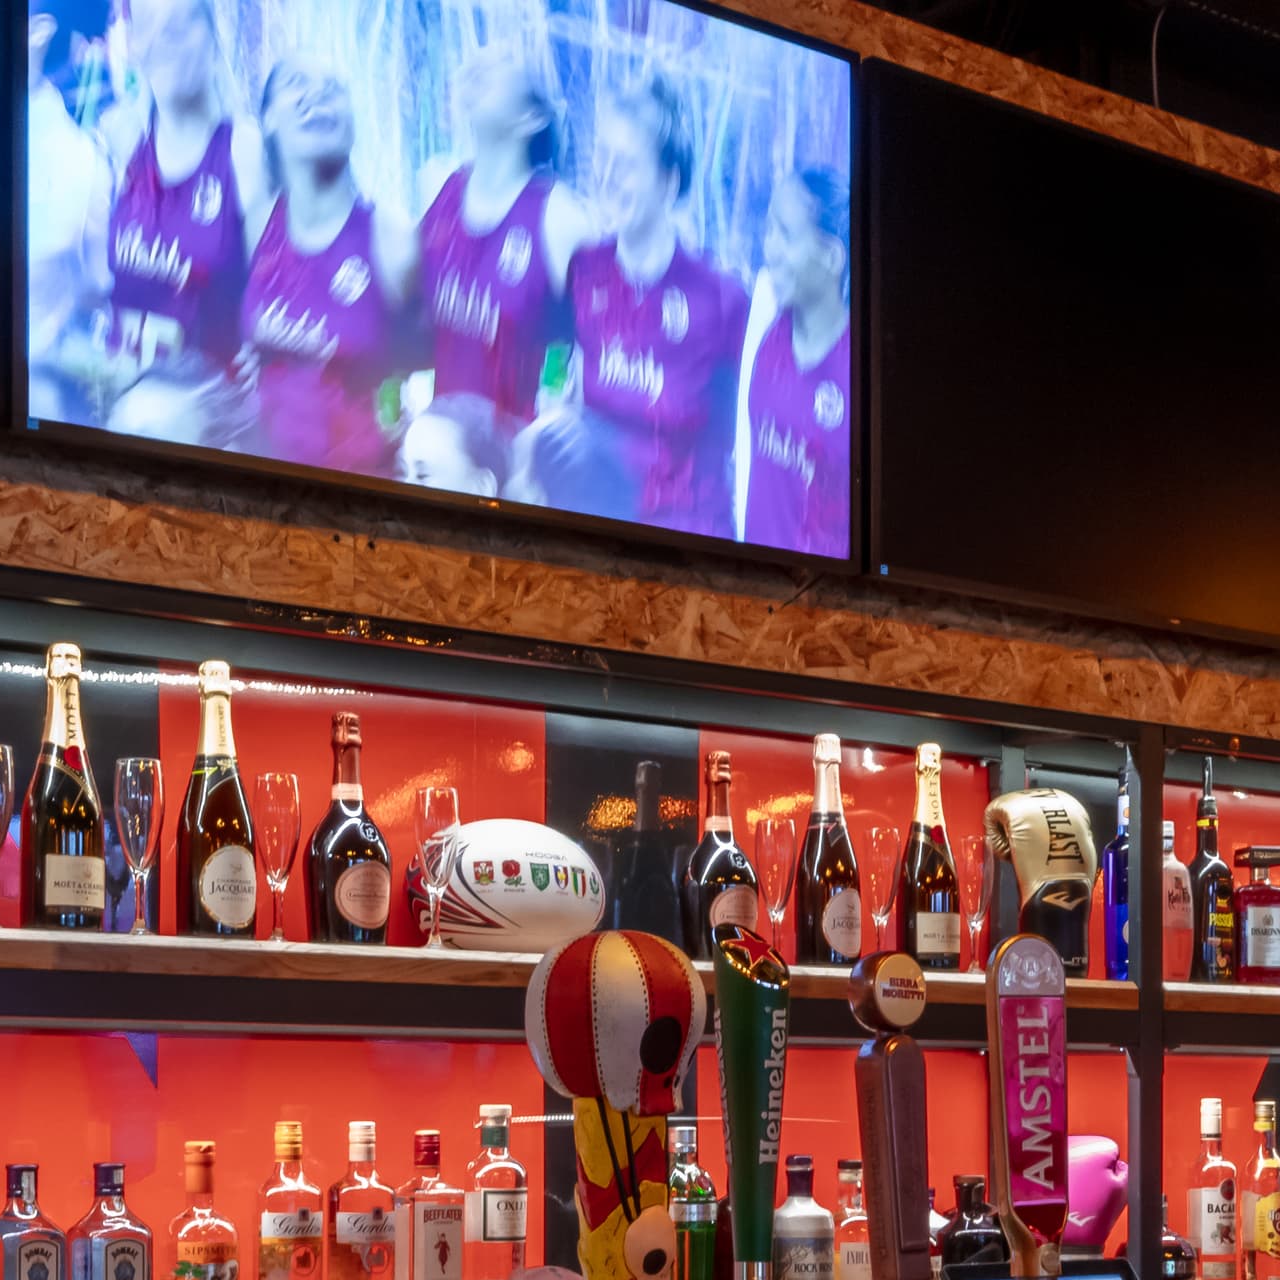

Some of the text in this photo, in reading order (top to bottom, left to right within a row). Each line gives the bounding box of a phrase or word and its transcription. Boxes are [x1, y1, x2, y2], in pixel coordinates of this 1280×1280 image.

[758, 1007, 788, 1166] Heineken
[1017, 1003, 1055, 1191] AMSTEL
[423, 1208, 463, 1224] BEEFEATER
